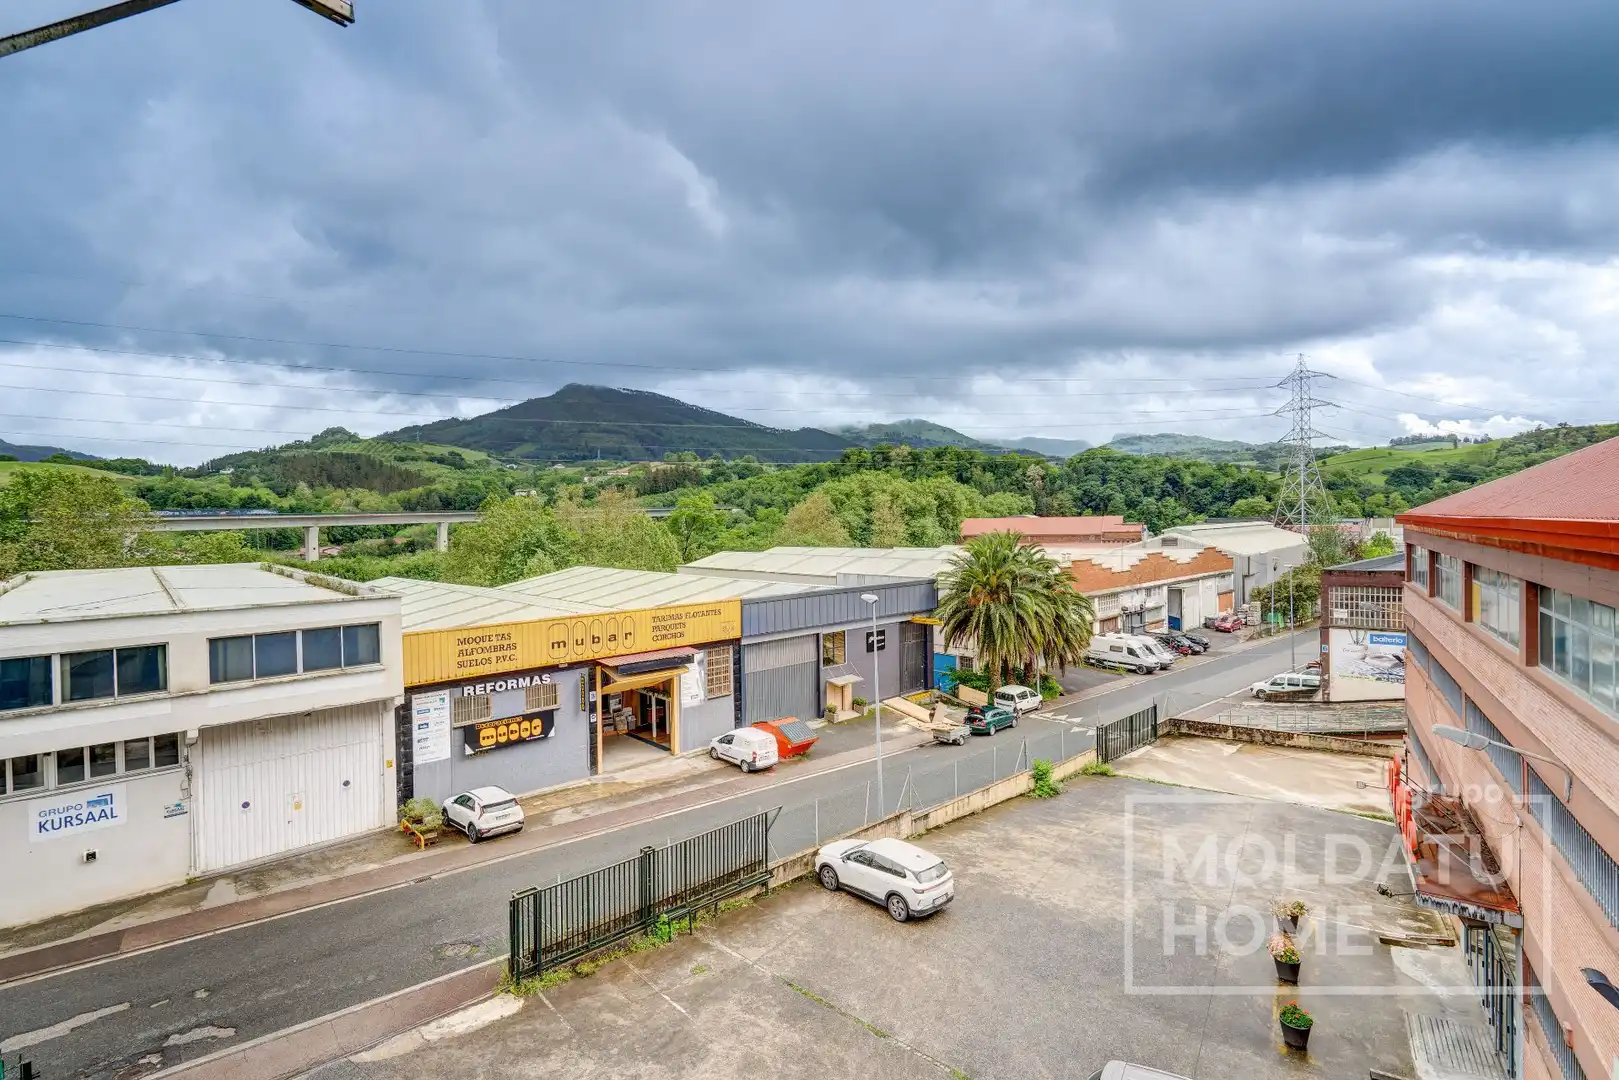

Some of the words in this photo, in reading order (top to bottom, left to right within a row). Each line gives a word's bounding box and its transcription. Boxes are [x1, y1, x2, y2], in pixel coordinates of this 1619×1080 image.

[652, 611, 683, 623] TARIMAS
[685, 608, 722, 619] FLOTANTES
[652, 621, 686, 632] PARQUETS
[551, 630, 632, 650] mubar
[652, 631, 685, 642] CORCHOS
[456, 642, 518, 658] ALFOMBRAS
[456, 658, 492, 669] SUELOS
[495, 653, 518, 664] P.V.C.
[463, 673, 551, 697] REFORMAS
[38, 803, 84, 818] GRUPO
[38, 806, 118, 834] KURSAAL
